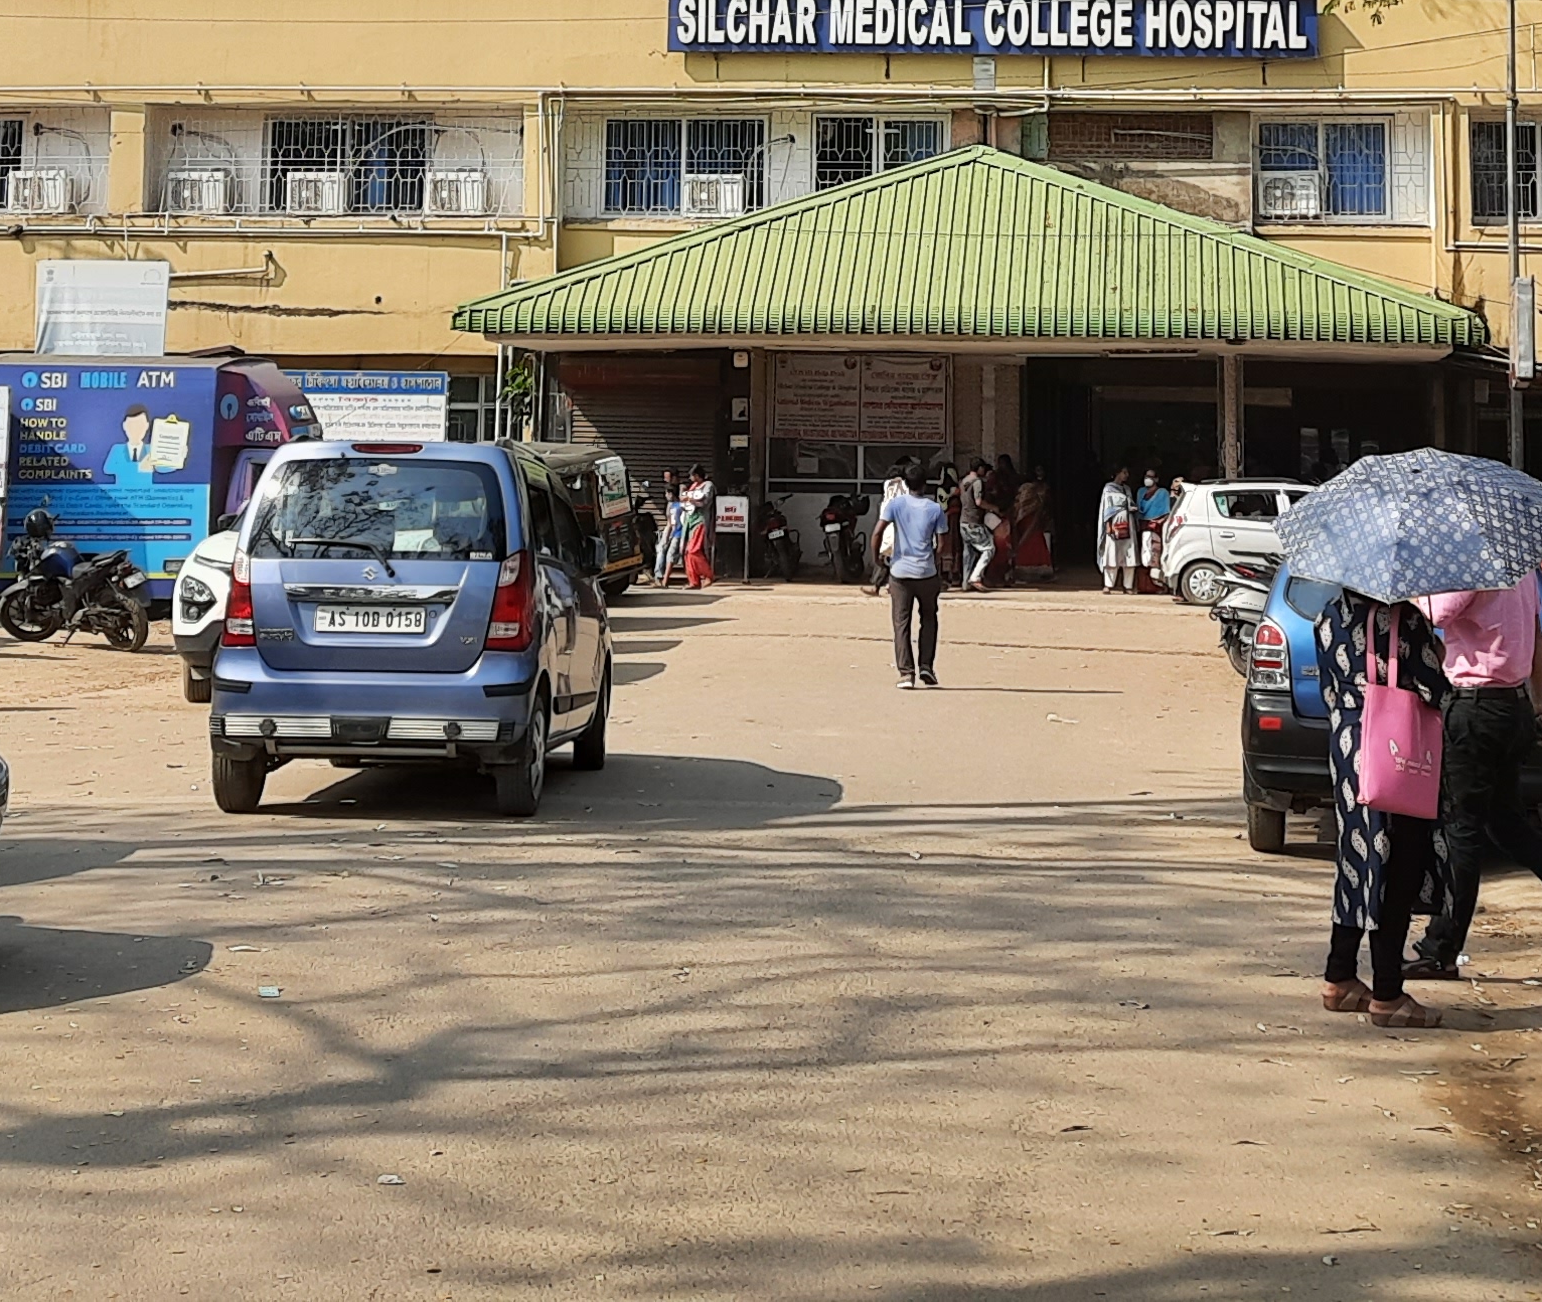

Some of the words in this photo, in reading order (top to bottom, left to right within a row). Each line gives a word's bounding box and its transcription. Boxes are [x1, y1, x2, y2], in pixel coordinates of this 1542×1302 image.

[1145, 0, 1308, 51] HOSPITAL
[40, 372, 68, 389] SBI
[79, 371, 128, 389] MOBILE
[137, 371, 175, 388] ATM
[35, 398, 57, 411] SBI
[20, 417, 48, 428] HOW
[50, 417, 67, 428] TO
[19, 431, 67, 441] HANDLE
[19, 444, 54, 454] DEBIT
[54, 443, 87, 454] CARD
[19, 456, 69, 467] RELATED
[18, 469, 93, 479] COMPLAINTS
[327, 611, 347, 628] AS
[385, 611, 423, 628] 0158
